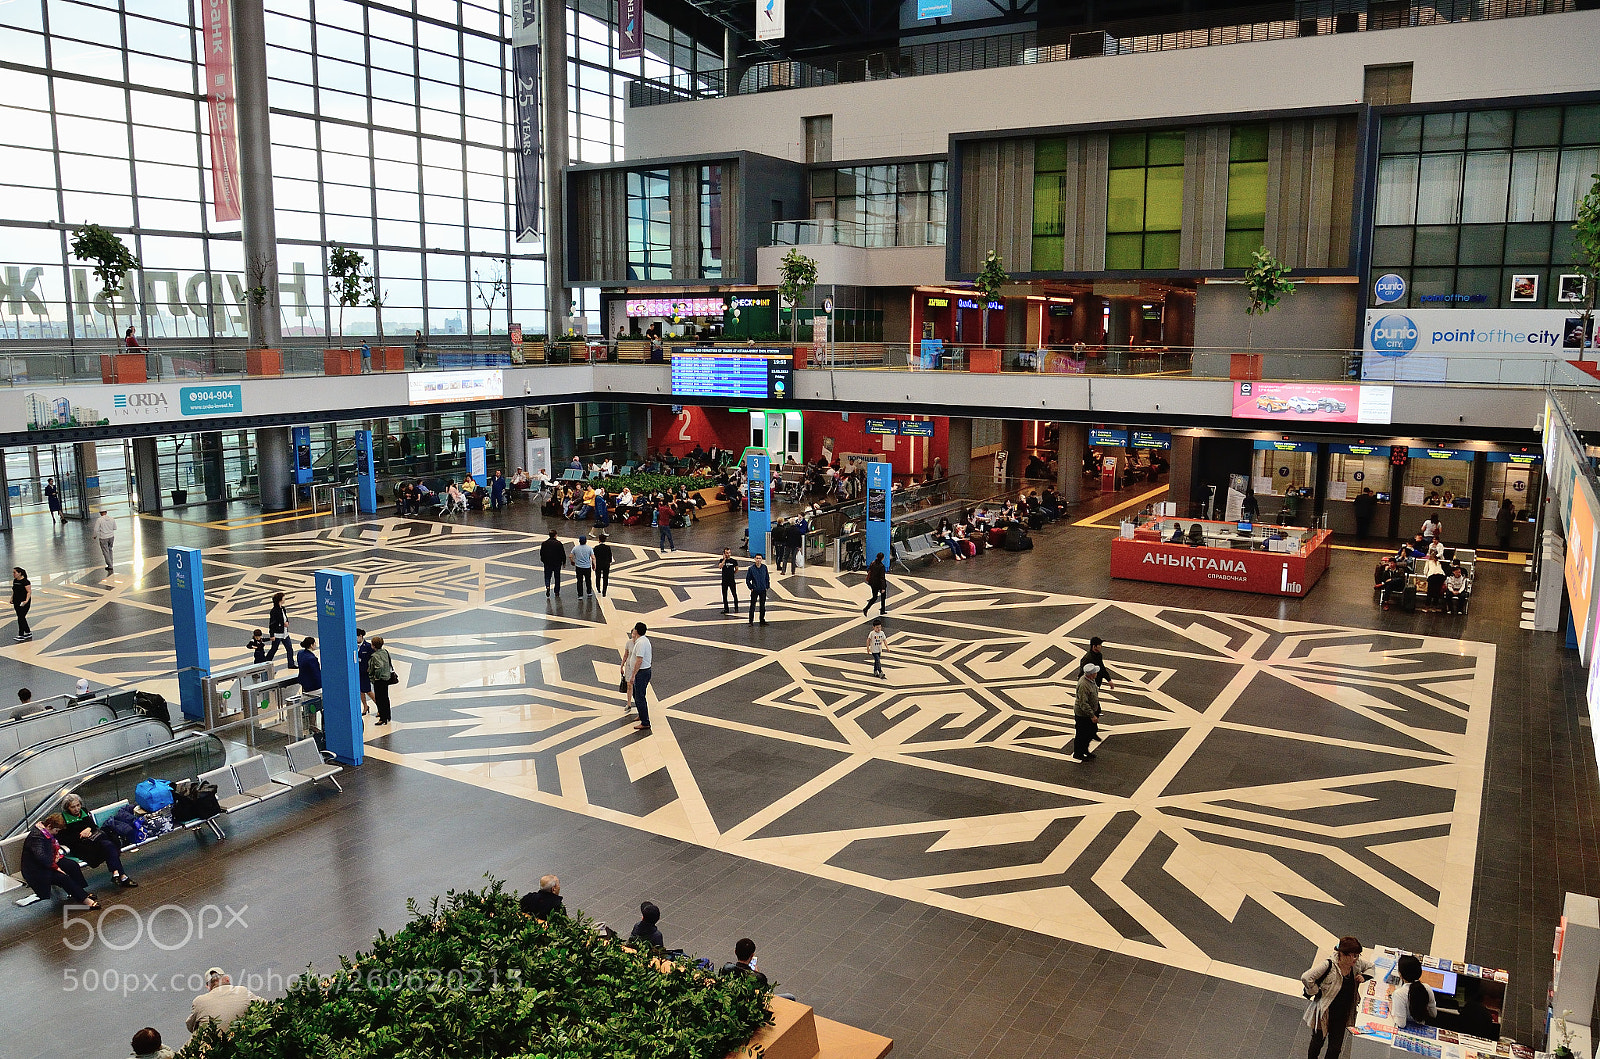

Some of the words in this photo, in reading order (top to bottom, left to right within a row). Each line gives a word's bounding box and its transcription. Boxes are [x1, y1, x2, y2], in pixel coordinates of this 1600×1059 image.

[518, 76, 534, 107] 25
[522, 116, 532, 156] YEARS
[735, 299, 771, 307] HECKPOINT
[1374, 327, 1418, 341] punto
[128, 392, 168, 407] ORDA
[197, 390, 233, 401] 904-904
[114, 407, 169, 416] INVEST
[679, 409, 691, 440] 2
[359, 432, 363, 440] 2
[753, 458, 759, 468] 3
[874, 465, 881, 476] 4
[1514, 482, 1525, 490] 10
[176, 553, 183, 569] 3
[1142, 552, 1248, 574] АНЫҚТАМА
[1207, 573, 1248, 582] СПРАВОЧНАЯ
[325, 578, 333, 596] 4
